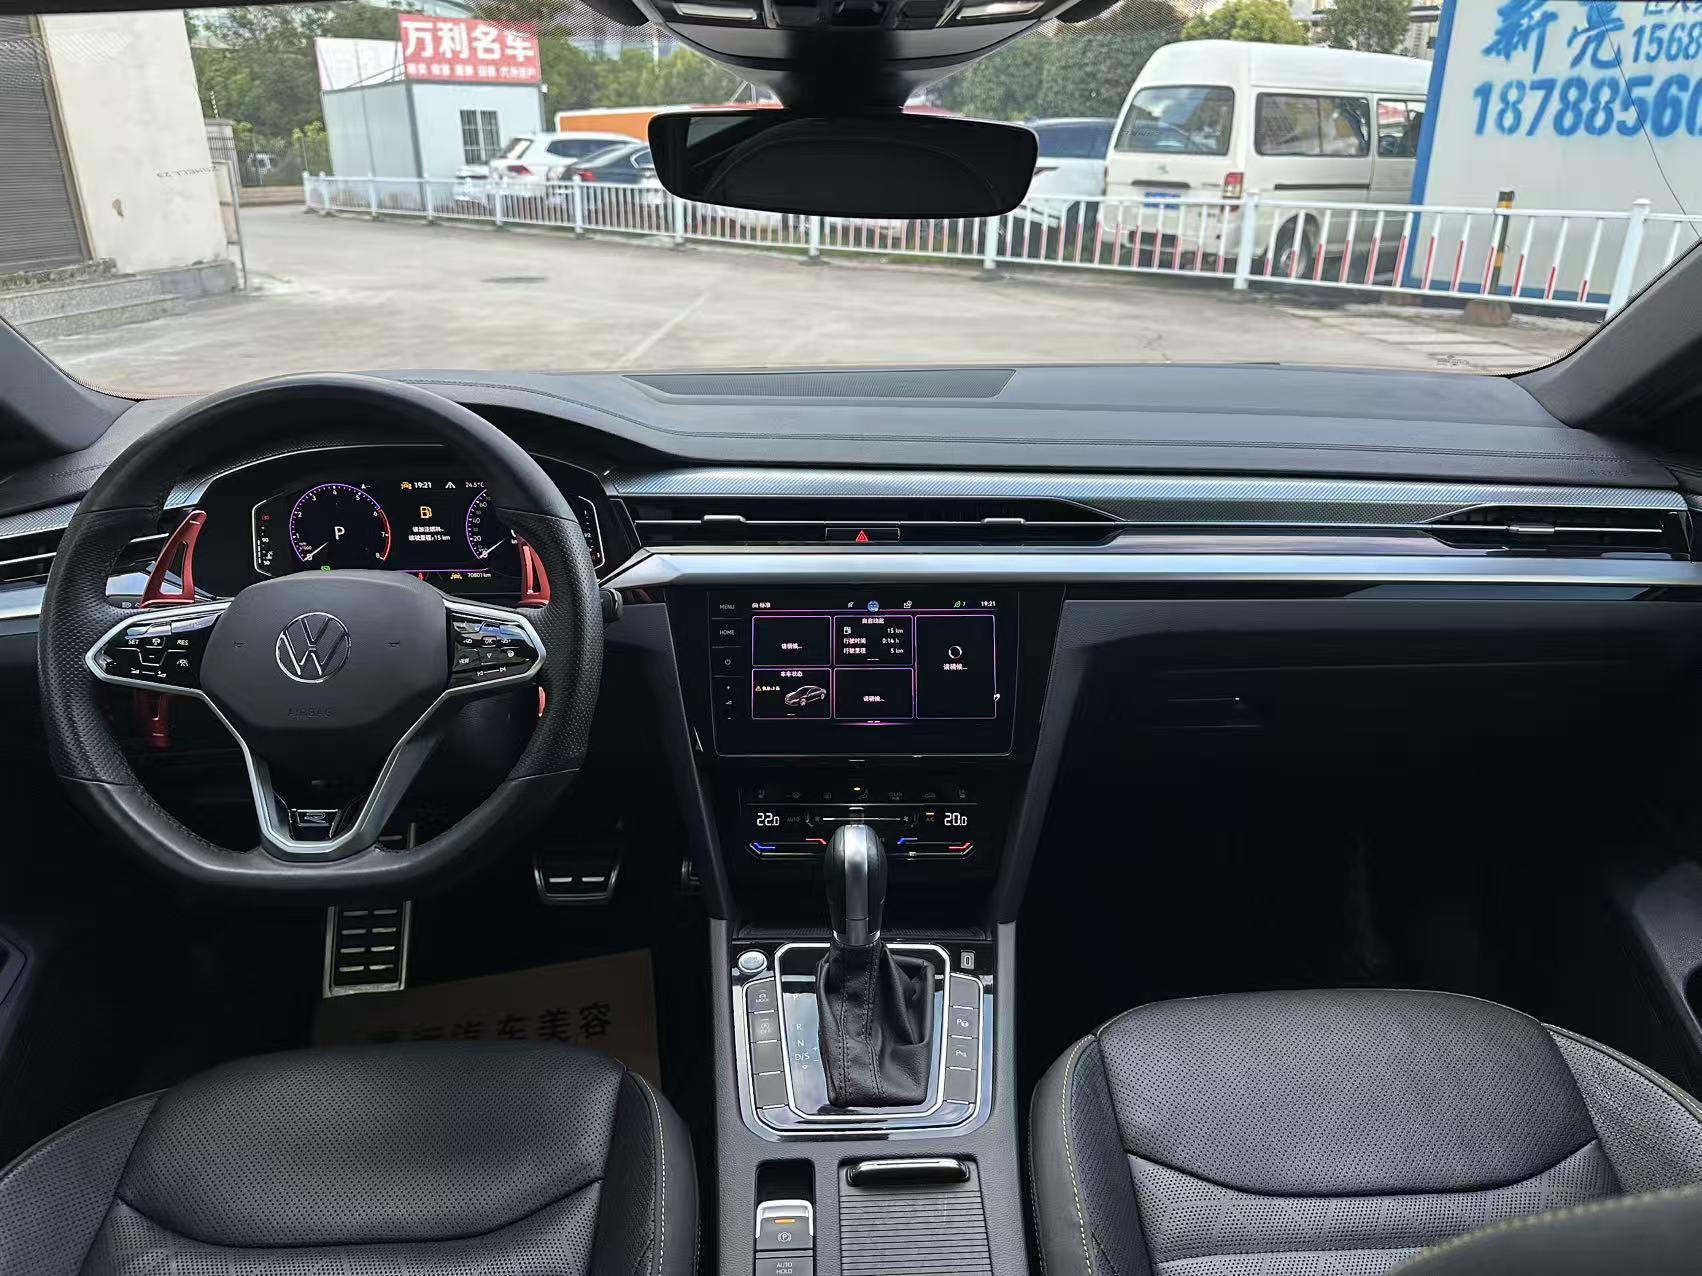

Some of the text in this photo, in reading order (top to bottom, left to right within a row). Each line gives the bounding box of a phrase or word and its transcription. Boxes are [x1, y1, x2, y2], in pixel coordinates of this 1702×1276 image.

[402, 20, 535, 62] 万利名车
[413, 481, 432, 489] 19:21
[334, 526, 345, 540] P
[288, 707, 332, 718] AIRBAG
[756, 812, 780, 826] 22.0
[944, 812, 968, 826] 20.0
[796, 1023, 802, 1031] R
[795, 1053, 810, 1061] D/S
